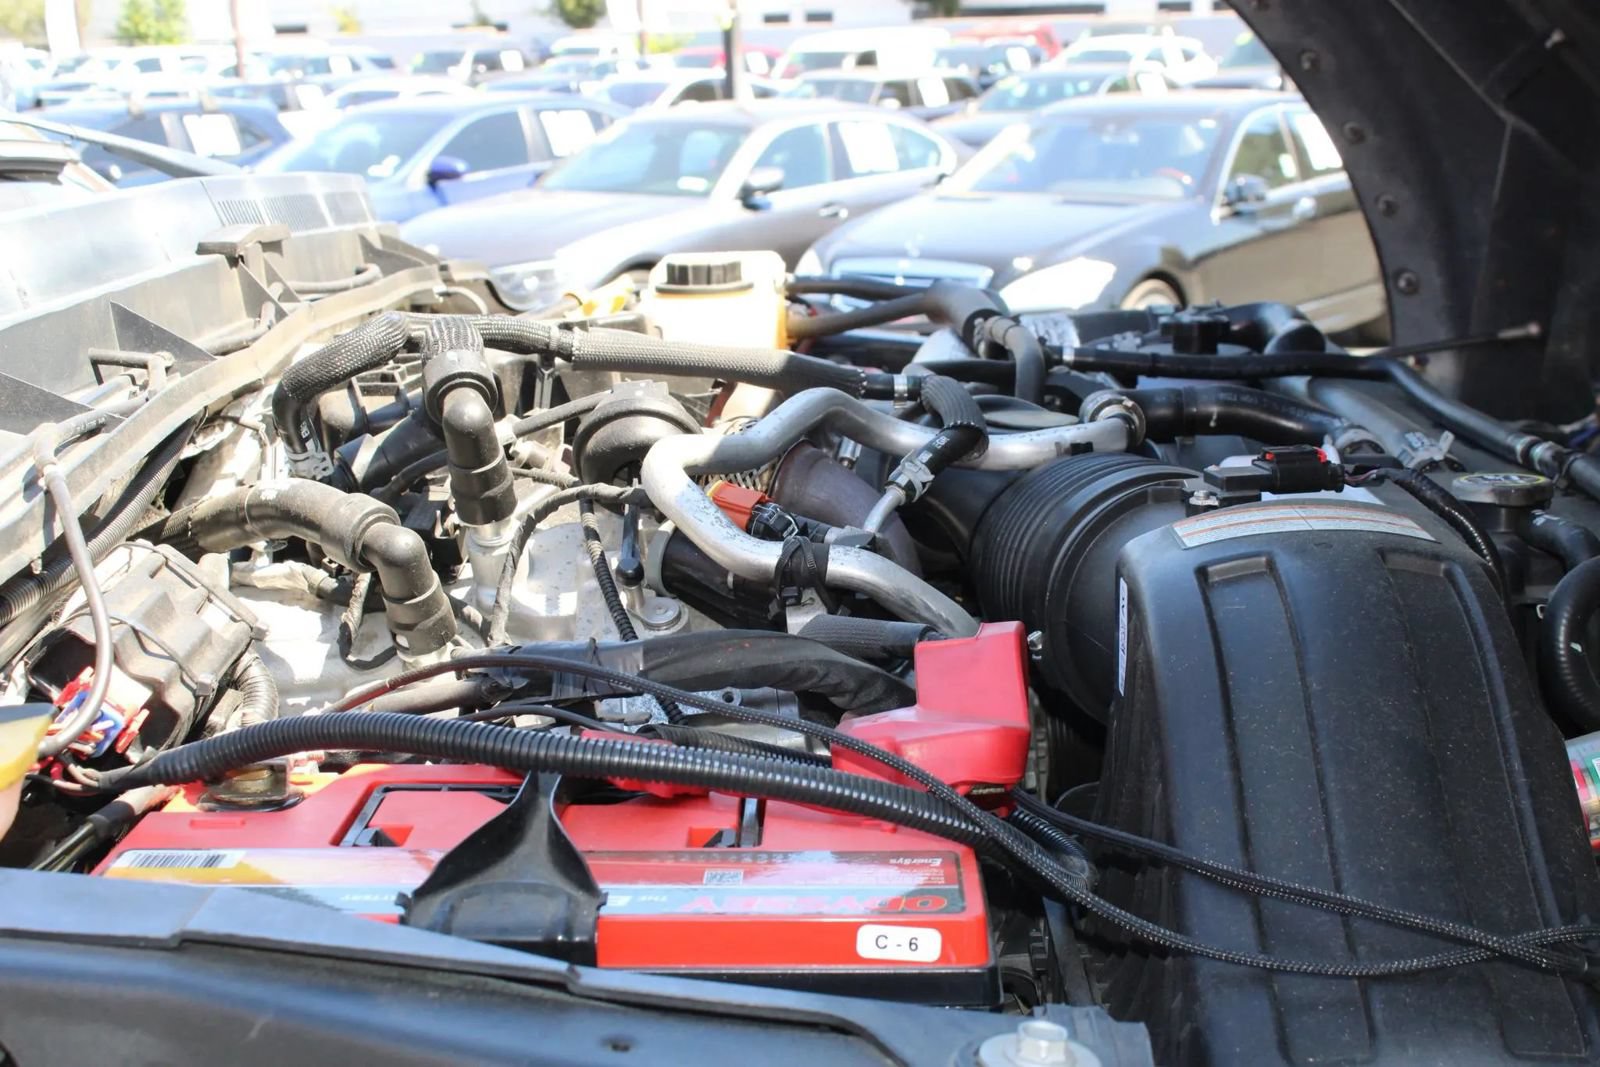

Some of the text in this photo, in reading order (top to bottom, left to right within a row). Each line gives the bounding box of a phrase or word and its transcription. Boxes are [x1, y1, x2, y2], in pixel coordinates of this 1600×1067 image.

[889, 857, 942, 867] EnerSys
[875, 934, 888, 950] C
[908, 937, 918, 952] 6
